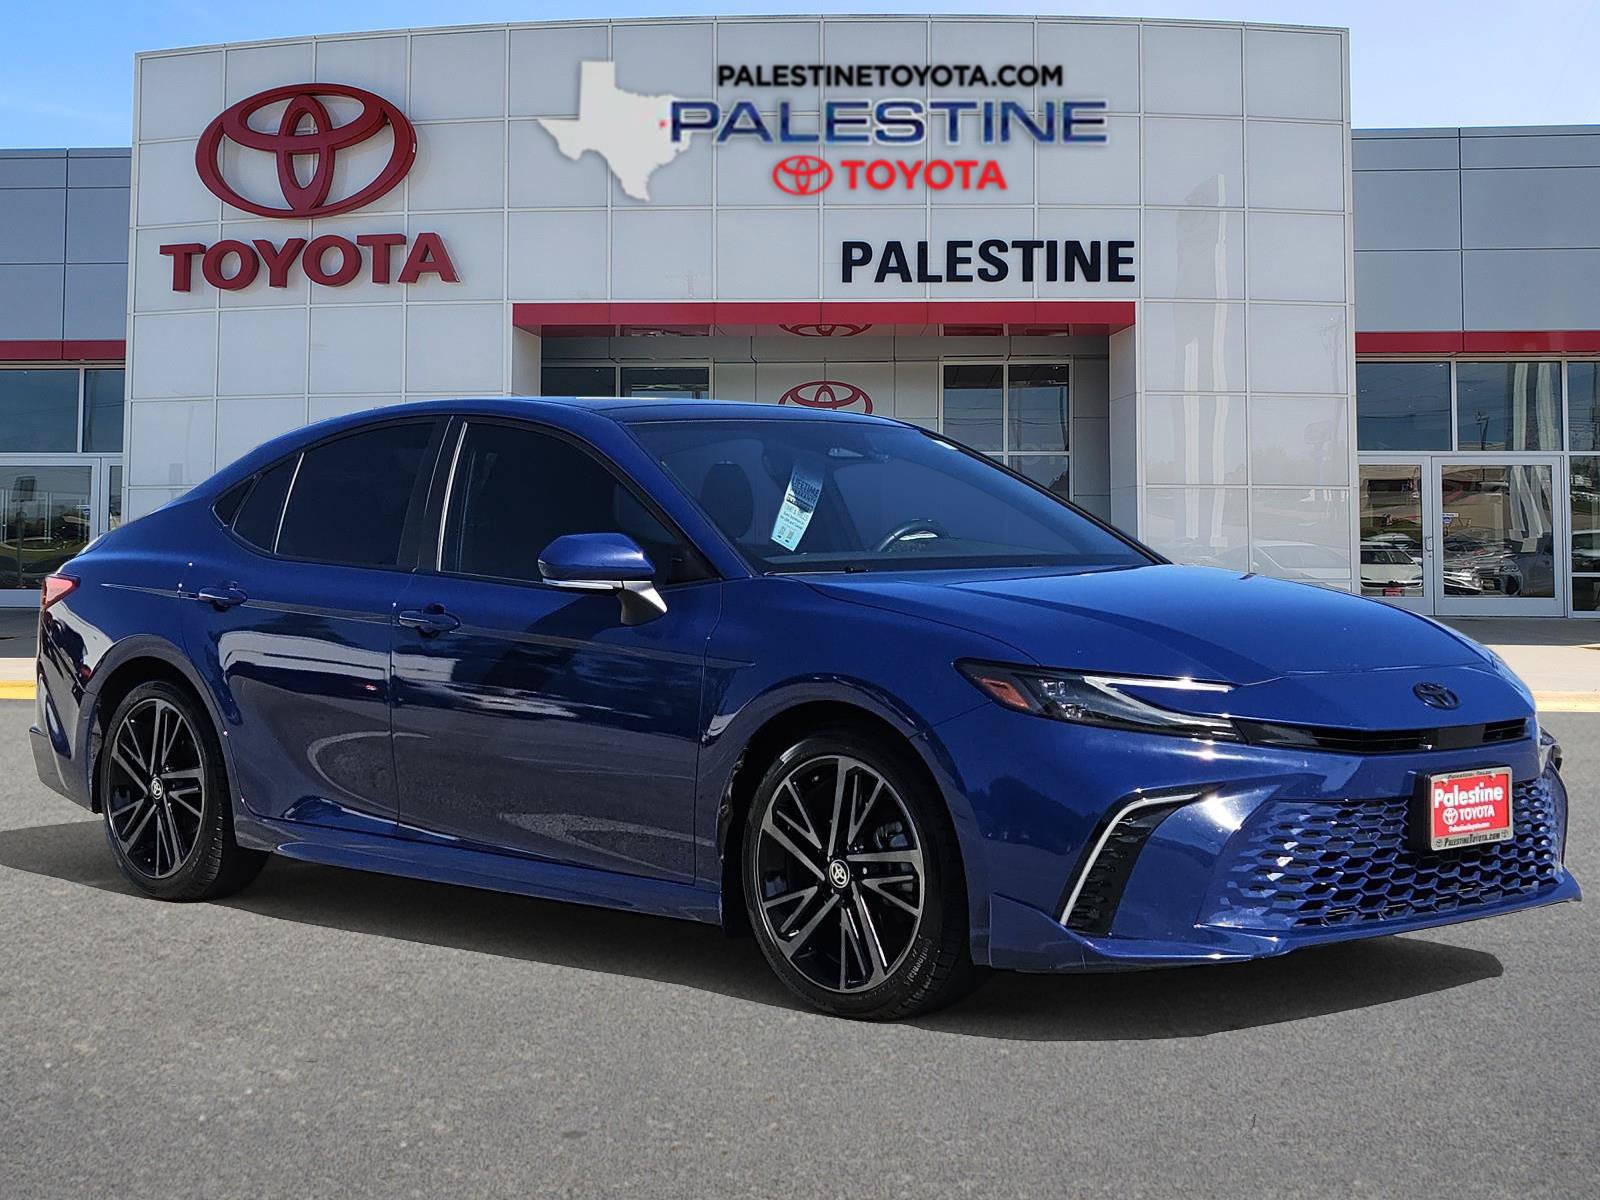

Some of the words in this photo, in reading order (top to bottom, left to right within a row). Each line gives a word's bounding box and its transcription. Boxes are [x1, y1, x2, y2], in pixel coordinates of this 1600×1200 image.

[159, 231, 461, 293] TOYOTA
[841, 239, 1136, 283] PALESTINE
[1434, 782, 1504, 808] Palestine
[1459, 805, 1495, 821] TOYOTA
